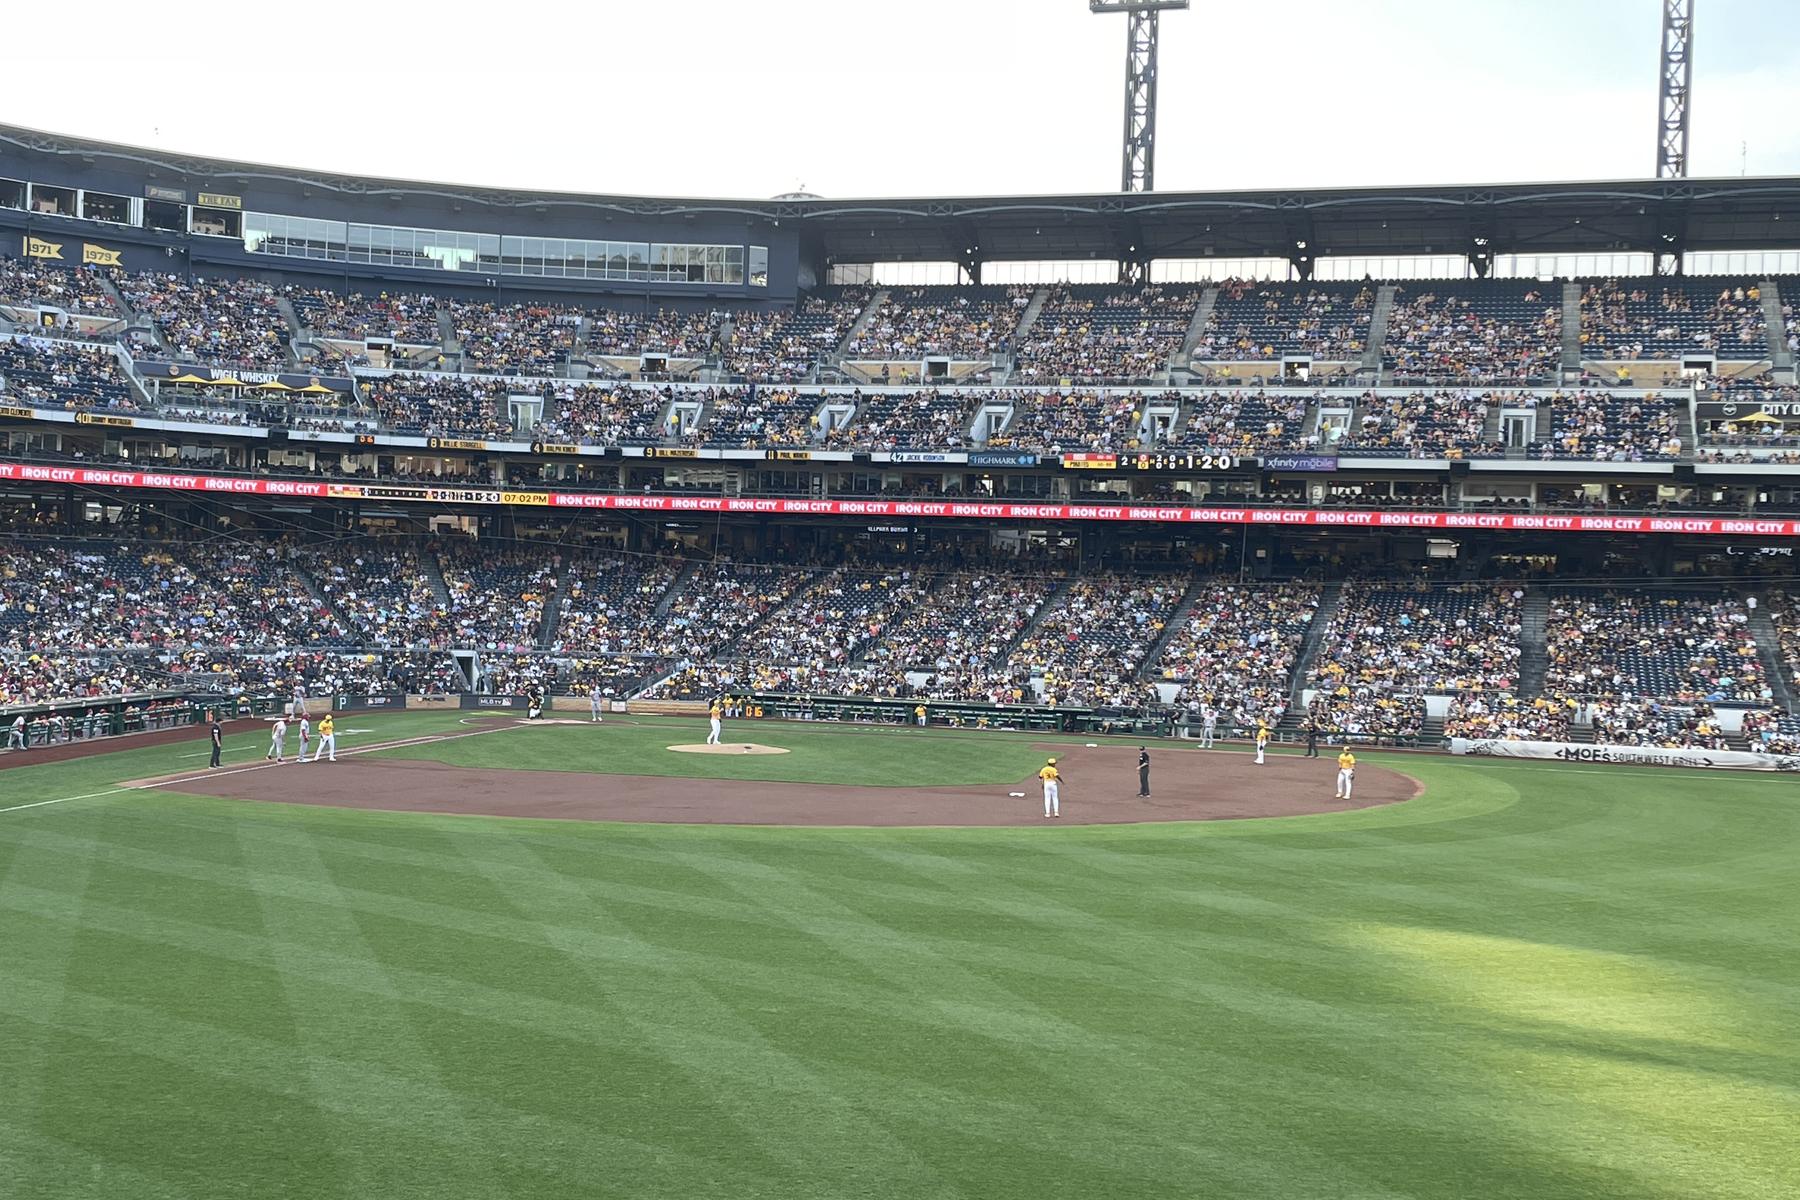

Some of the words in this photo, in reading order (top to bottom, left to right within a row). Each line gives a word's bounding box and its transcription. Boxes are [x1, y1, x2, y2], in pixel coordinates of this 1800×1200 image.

[30, 244, 52, 254] 971
[86, 250, 112, 262] 1979
[240, 372, 280, 382] WHISKEY
[1762, 404, 1790, 415] CITY
[76, 412, 87, 424] 40
[430, 439, 437, 448] 8
[535, 444, 541, 453] 4
[646, 448, 653, 458] 9
[768, 451, 775, 460] 11
[891, 452, 903, 462] 42
[973, 456, 1016, 465] HIGHMARK
[1121, 457, 1128, 466] 2
[1186, 456, 1193, 469] 1
[1201, 456, 1212, 469] 2
[1218, 456, 1230, 469] 0
[1268, 458, 1298, 468] xfinity
[22, 468, 49, 478] IRON
[51, 470, 75, 480] CITY
[84, 472, 110, 482] IRON
[112, 474, 134, 484] CITY
[143, 476, 170, 486] IRON
[173, 478, 196, 488] CITY
[205, 480, 232, 490] IRON
[234, 481, 258, 490] CITY
[266, 483, 294, 492] IRON
[296, 484, 320, 494] CITY
[504, 494, 531, 502] 07:02
[533, 494, 547, 503] PM
[557, 495, 583, 504] IRON
[585, 496, 608, 506] CITY
[615, 498, 640, 507] IRON
[642, 498, 664, 508] CITY
[672, 499, 698, 508] IRON
[700, 500, 722, 509] CITY
[729, 500, 754, 510] IRON
[756, 501, 778, 510] CITY
[784, 502, 809, 510] IRON
[811, 502, 832, 512] CITY
[840, 503, 864, 512] IRON
[867, 504, 888, 512] CITY
[896, 504, 921, 512] IRON
[923, 504, 946, 514] CITY
[953, 506, 978, 514] IRON
[981, 506, 1004, 514] CITY
[1011, 506, 1037, 516] IRON
[1039, 507, 1062, 516] CITY
[1070, 508, 1096, 516] IRON
[1098, 508, 1122, 518] CITY
[1130, 509, 1156, 518] IRON
[1159, 510, 1182, 519] CITY
[1191, 510, 1218, 520] IRON
[1220, 511, 1244, 520] CITY
[1253, 512, 1281, 522] IRON
[1283, 512, 1308, 522] CITY
[1316, 512, 1344, 522] IRON
[1347, 513, 1372, 523] CITY
[1381, 514, 1409, 524] IRON
[1412, 514, 1438, 524] CITY
[1446, 516, 1476, 525] IRON
[1478, 516, 1504, 526] CITY
[1513, 517, 1543, 527] IRON
[1546, 518, 1572, 528] CITY
[1581, 519, 1612, 528] IRON
[1615, 520, 1642, 529] CITY
[1651, 520, 1682, 530] IRON
[1685, 522, 1712, 530] CITY
[1721, 522, 1754, 532] IRON
[1756, 524, 1784, 532] CITY
[1613, 753, 1670, 764] SOUTHWEST
